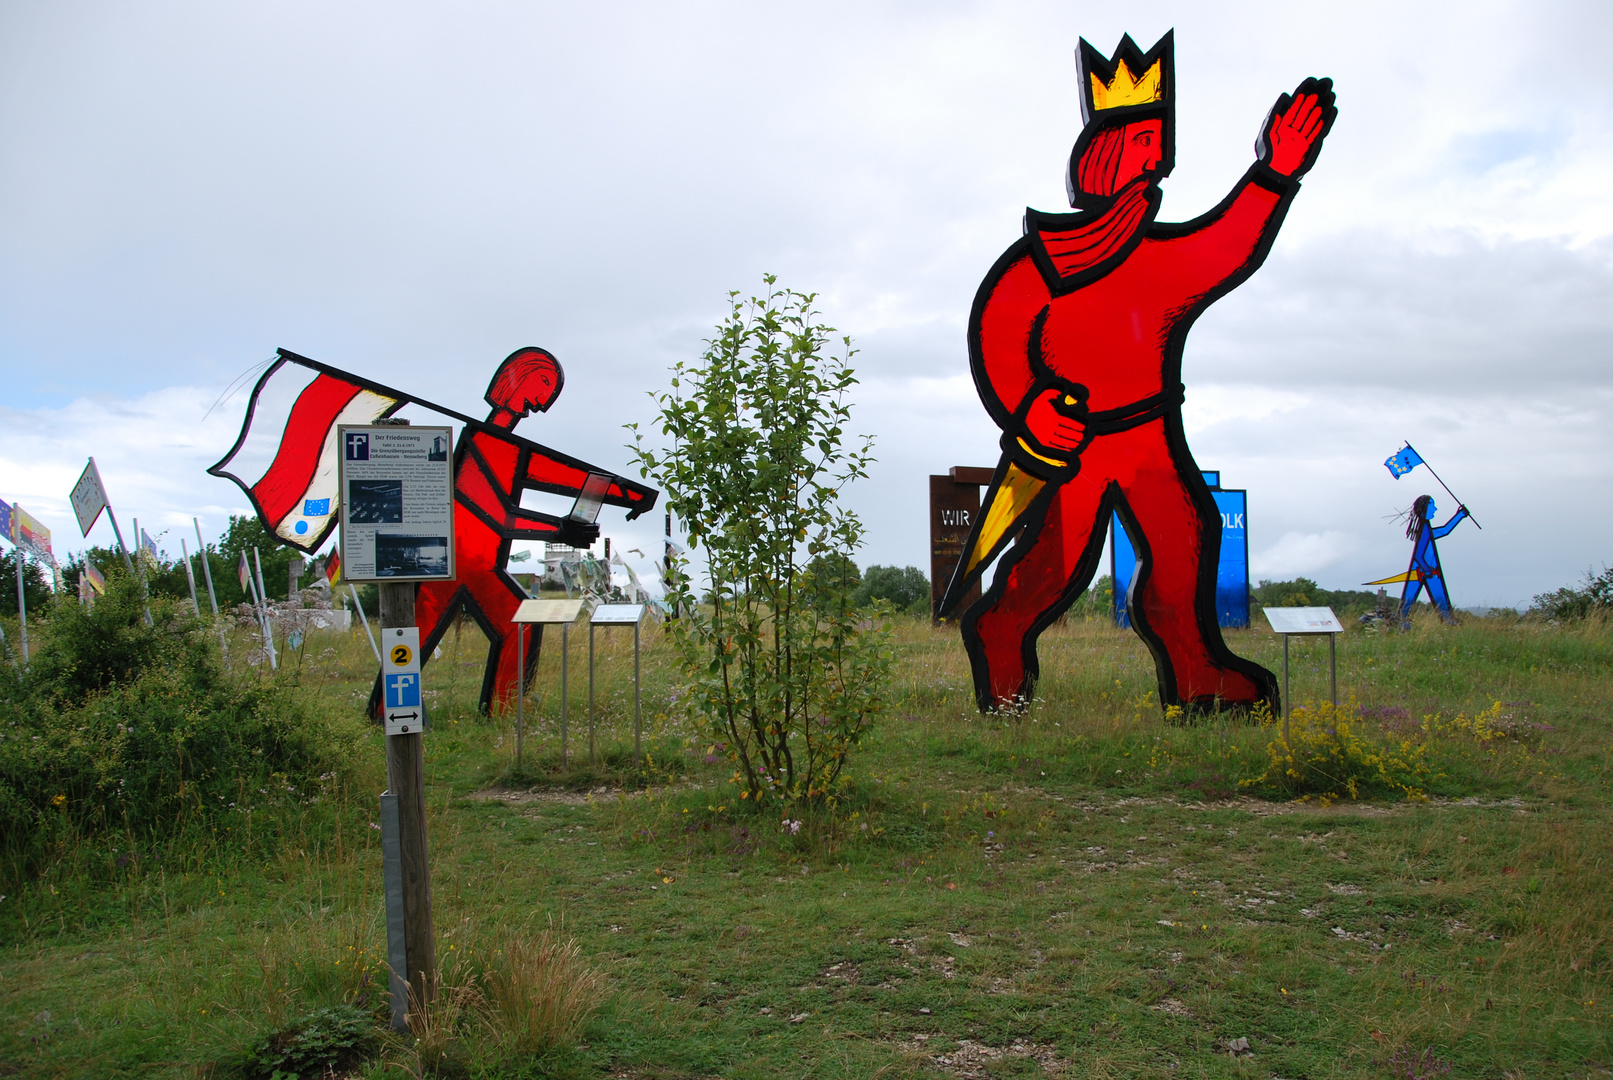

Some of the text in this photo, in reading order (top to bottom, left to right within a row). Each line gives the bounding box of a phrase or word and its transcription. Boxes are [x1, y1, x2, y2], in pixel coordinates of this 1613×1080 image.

[386, 434, 421, 442] Friedensweg
[941, 509, 970, 526] WIR
[1219, 513, 1244, 529] OLK
[394, 648, 407, 663] 2
